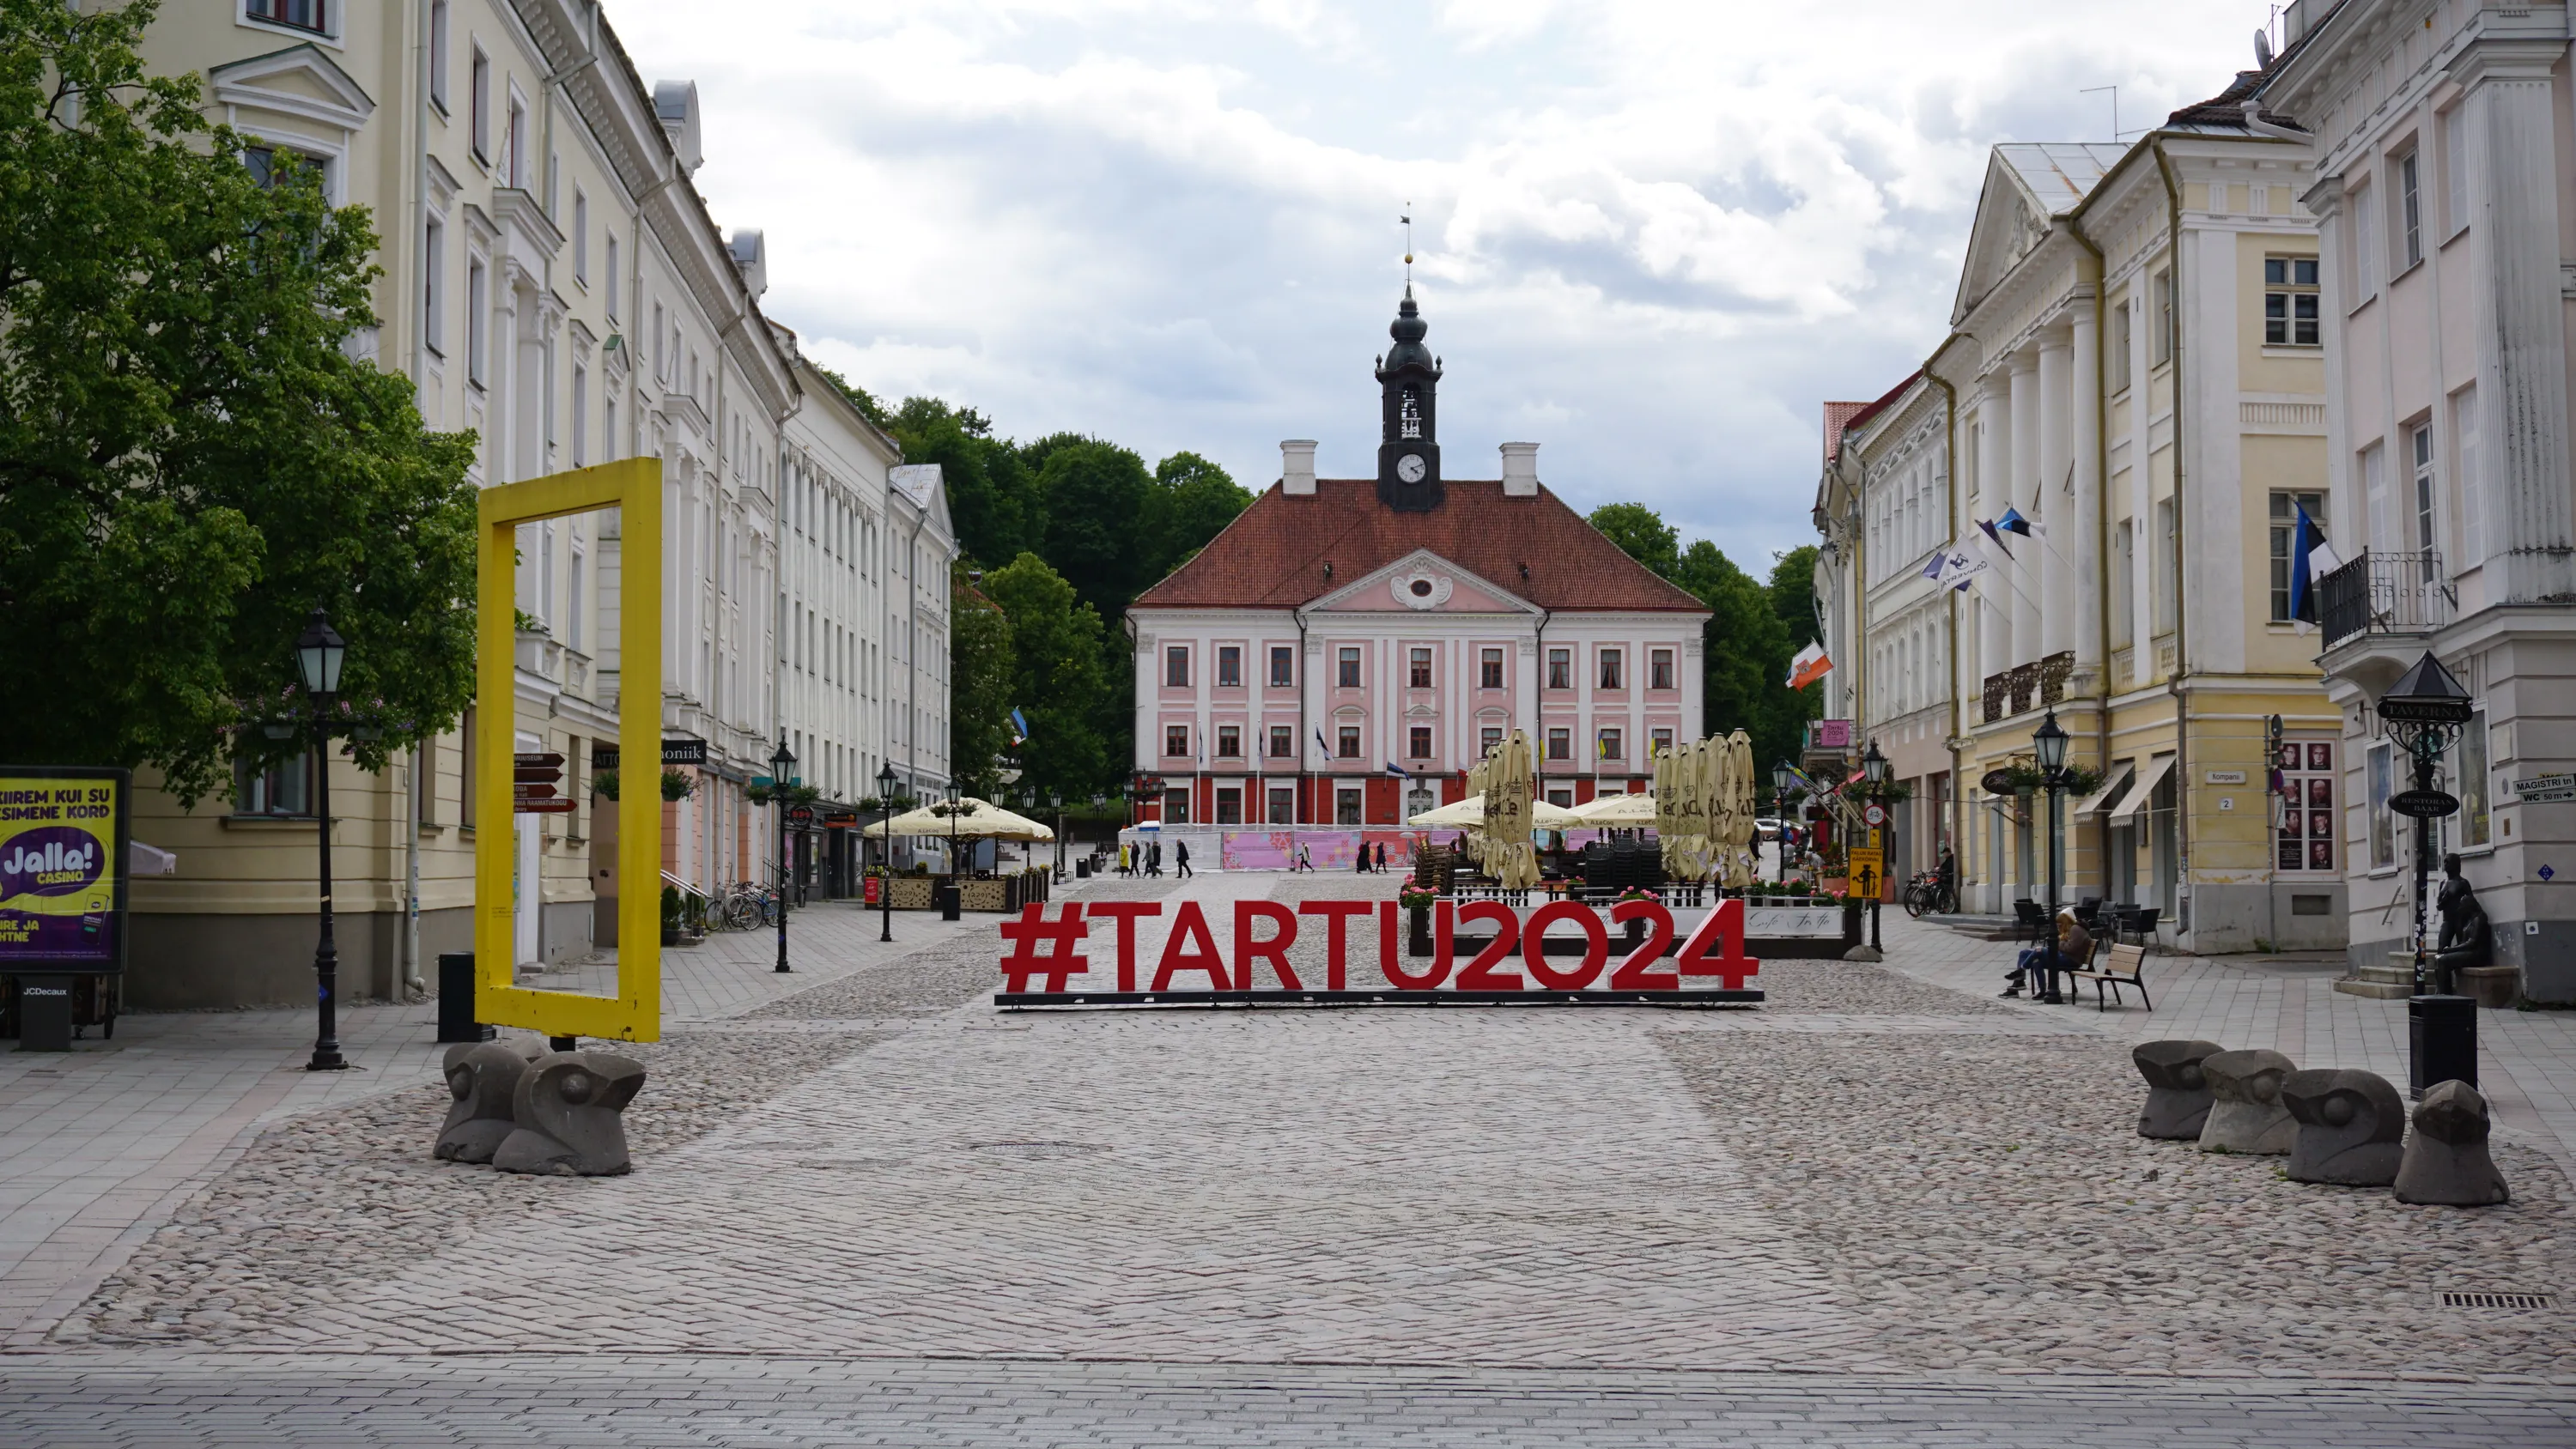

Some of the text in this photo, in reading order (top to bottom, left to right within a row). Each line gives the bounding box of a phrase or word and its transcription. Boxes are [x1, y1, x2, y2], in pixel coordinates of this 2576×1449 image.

[2387, 705, 2464, 718] TAVERNA
[2517, 779, 2561, 791] MAGISTRI
[55, 789, 82, 803] KUI
[88, 788, 111, 803] SU
[2523, 793, 2540, 802] WC
[67, 805, 111, 819] KORD
[3, 842, 93, 875] Jalla!
[37, 870, 85, 885] CASINO
[23, 920, 39, 931] JA
[1001, 899, 1759, 993] #TARTU2024
[24, 987, 67, 996] JCDecaux
